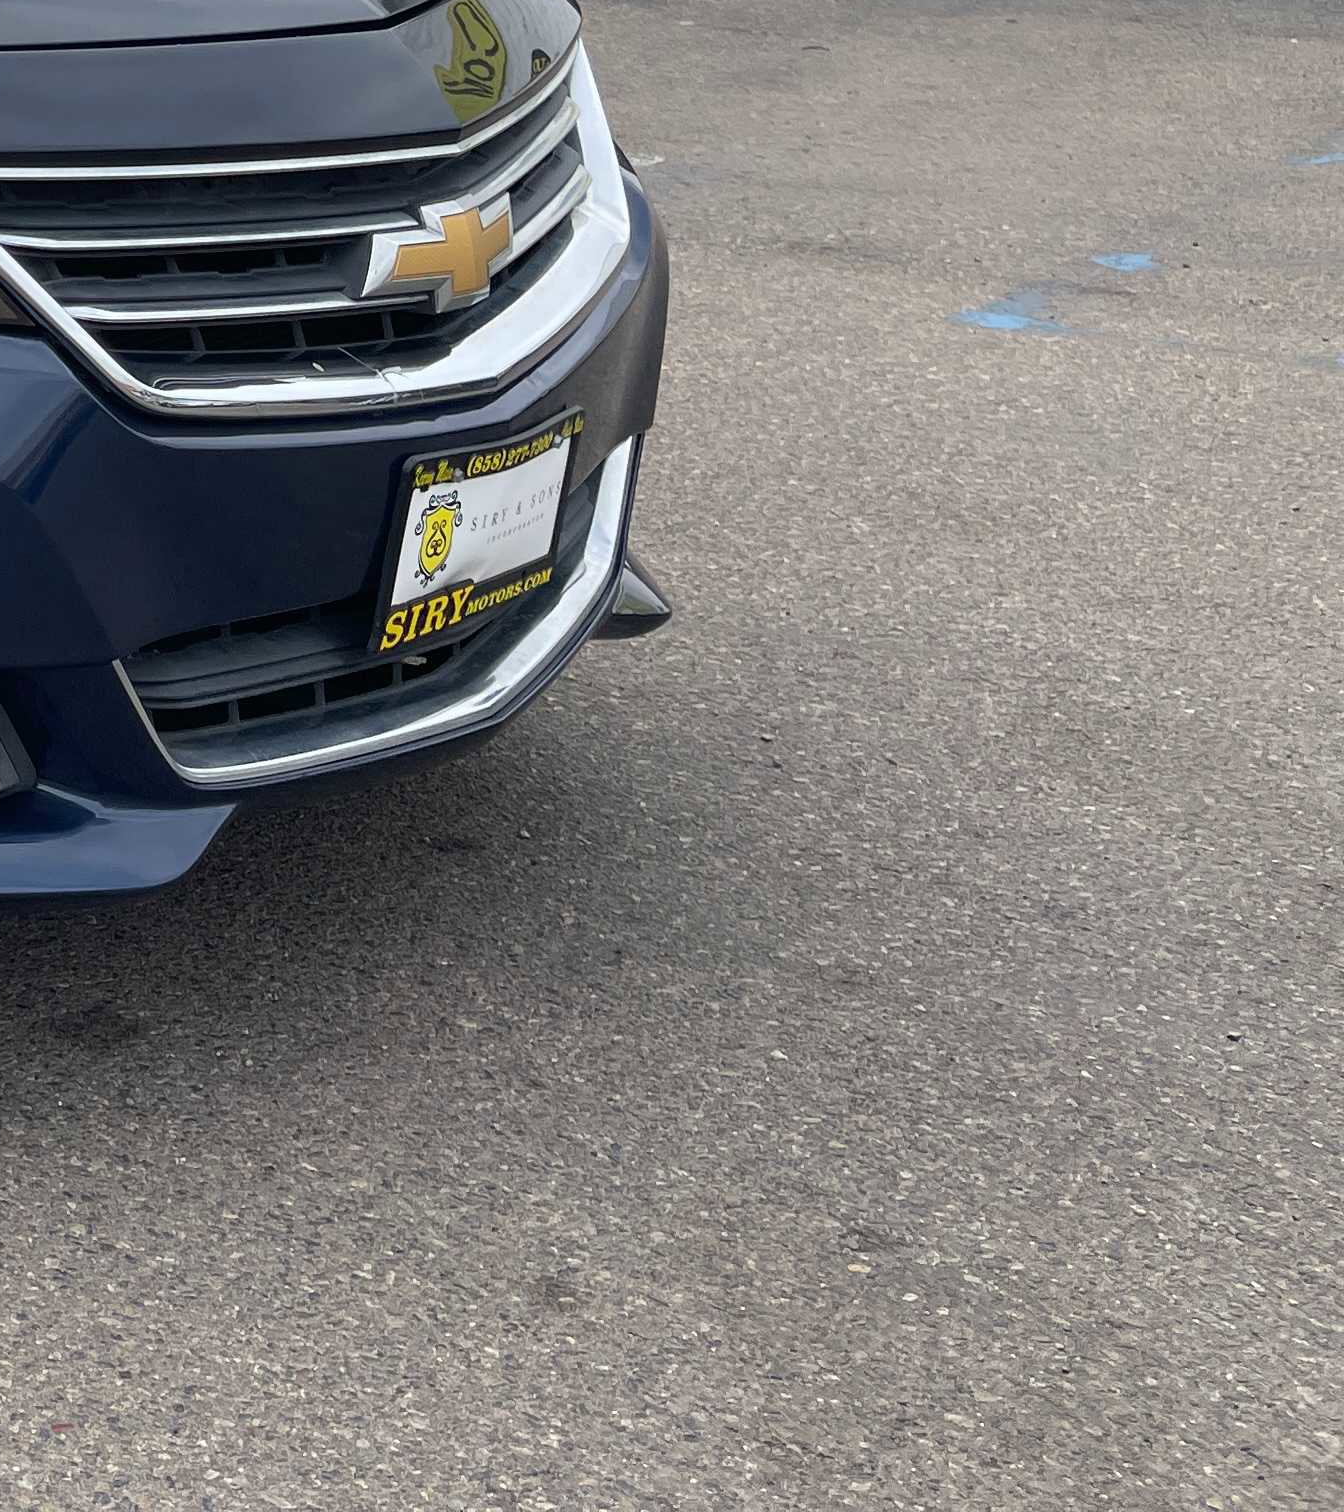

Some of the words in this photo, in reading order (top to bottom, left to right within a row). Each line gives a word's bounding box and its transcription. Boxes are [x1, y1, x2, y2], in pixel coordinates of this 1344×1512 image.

[470, 507, 509, 532] SIRY
[379, 584, 476, 654] SIRY
[465, 567, 553, 617] MOTORS.COM
